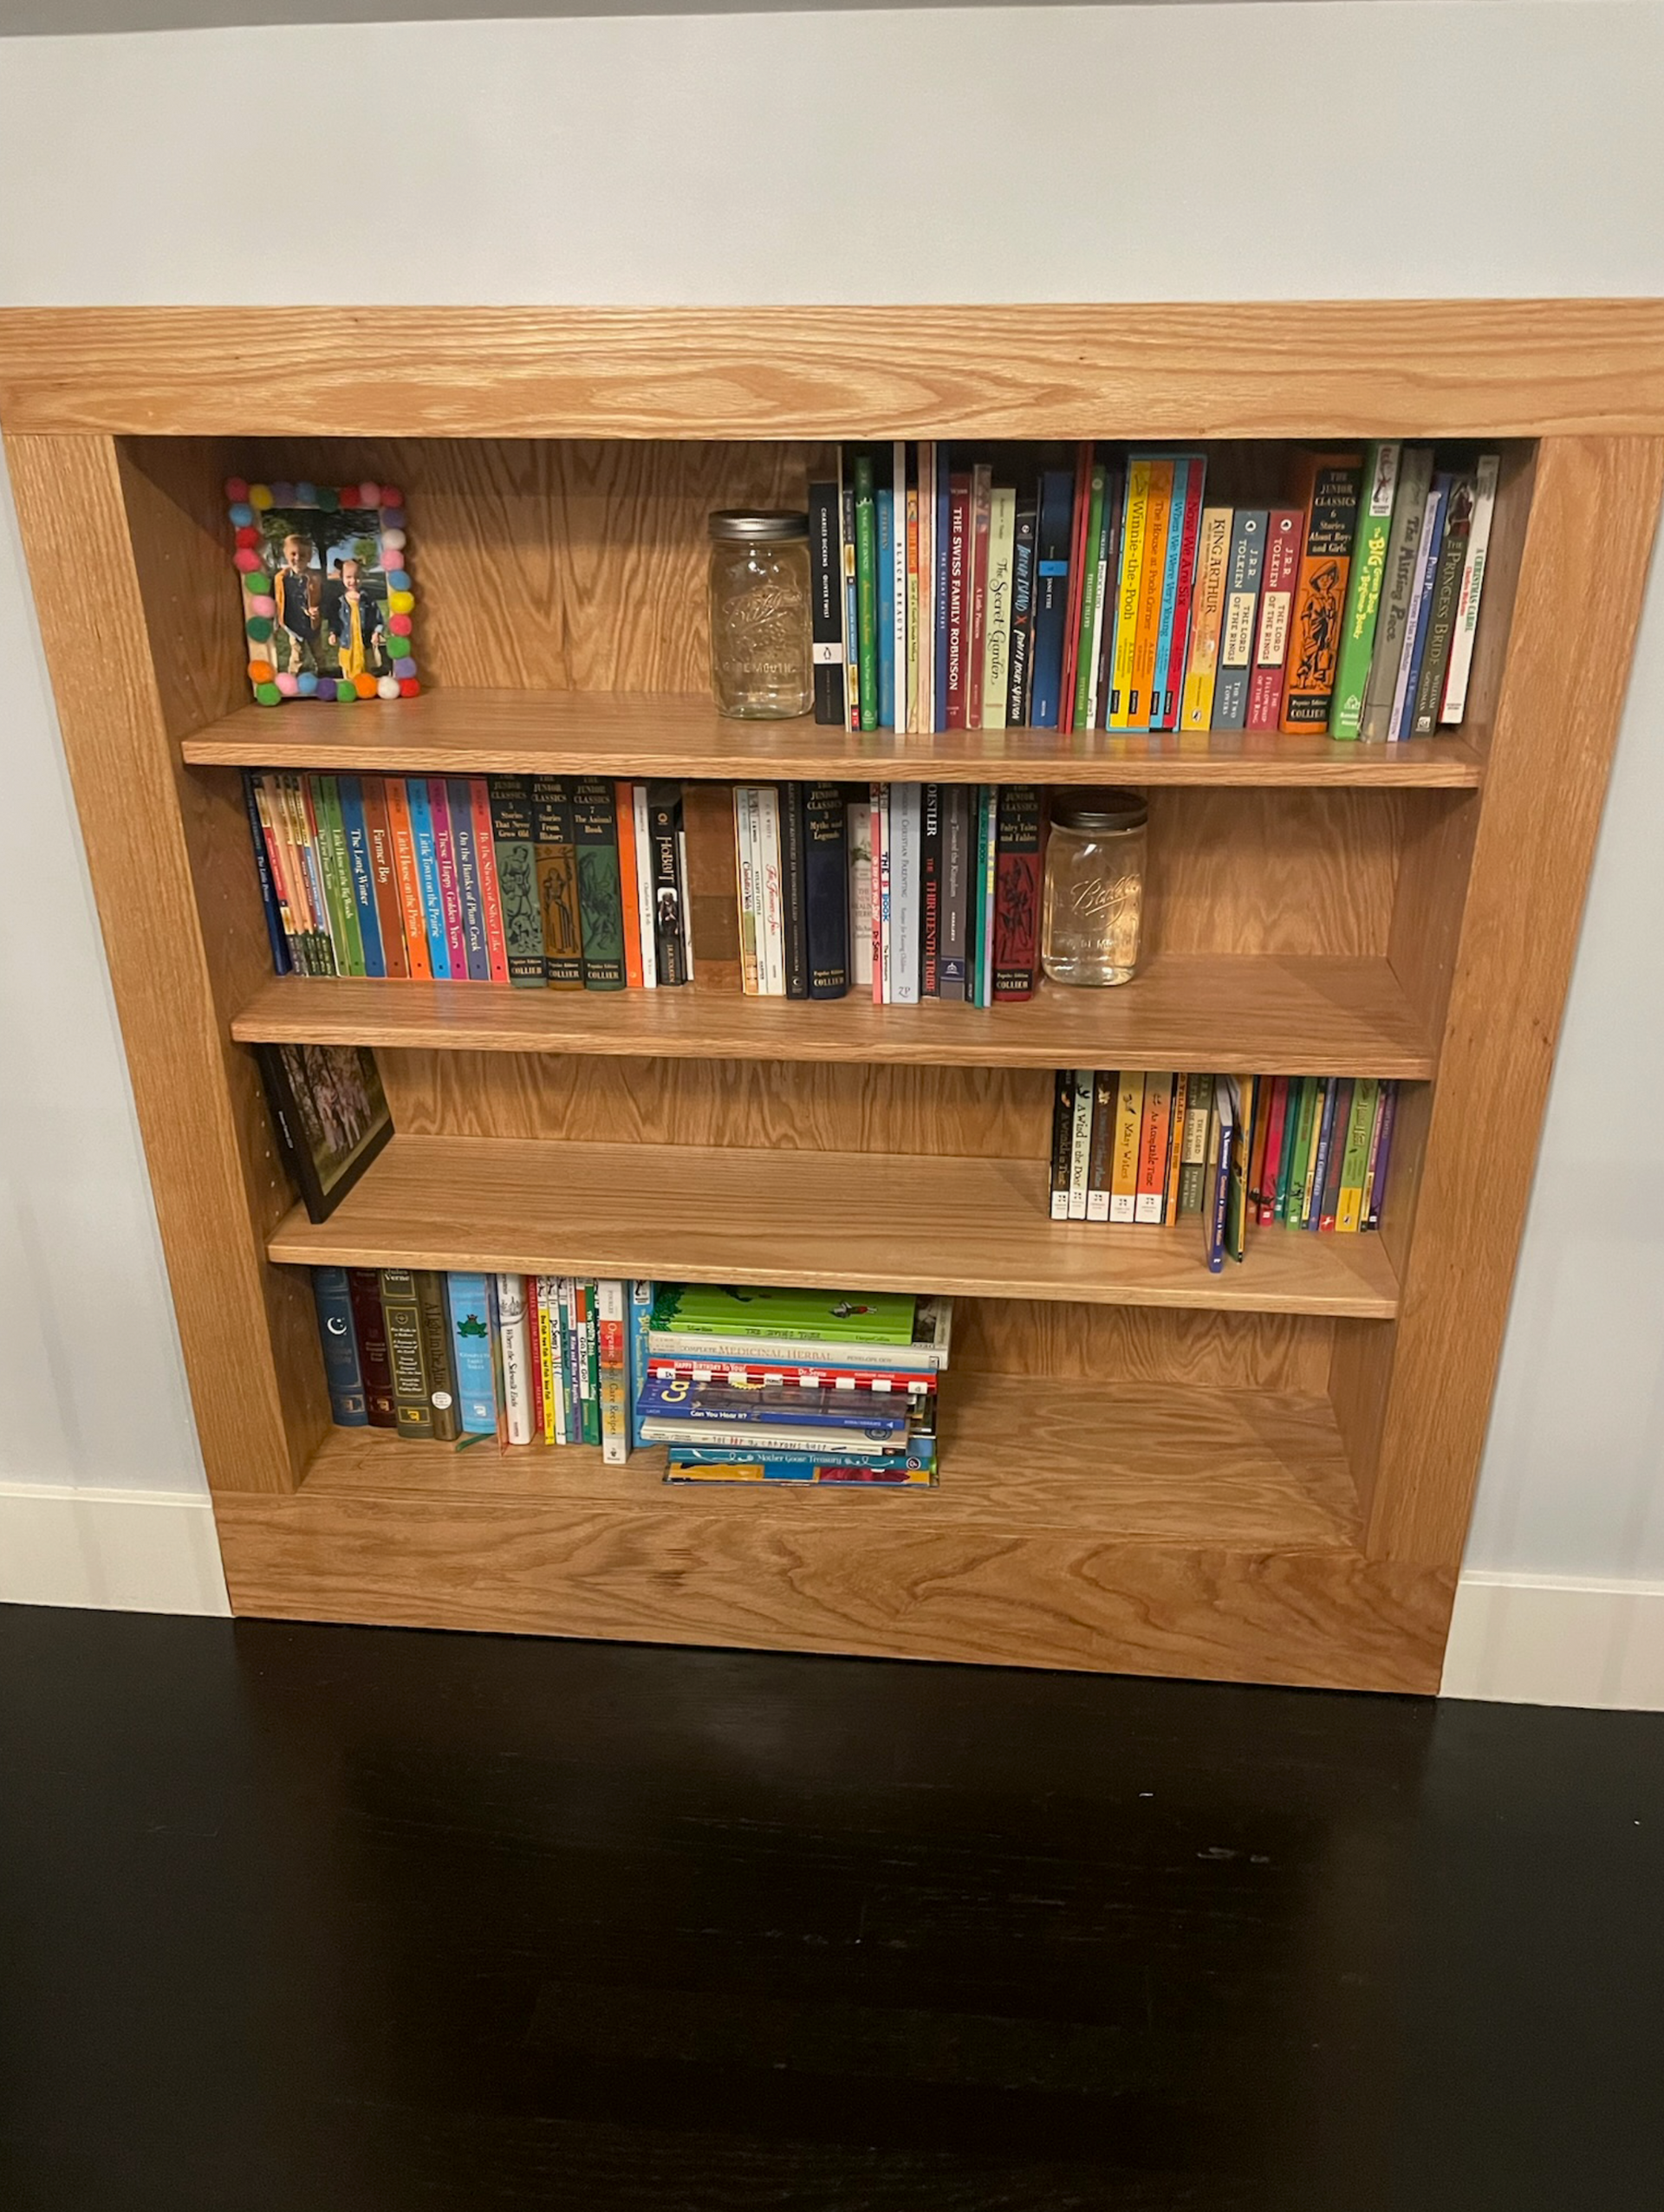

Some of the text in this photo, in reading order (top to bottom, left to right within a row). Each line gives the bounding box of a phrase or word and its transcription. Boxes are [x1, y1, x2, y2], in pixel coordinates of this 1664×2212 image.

[1320, 483, 1353, 495] JUNIOR
[1154, 501, 1164, 521] The
[1315, 497, 1355, 506] CLASSICS
[1172, 502, 1183, 532] When
[1151, 523, 1162, 555] House
[1170, 535, 1180, 550] We
[1212, 519, 1225, 555] KING
[1150, 557, 1158, 567] at
[1178, 502, 1197, 607] Now We Are Six
[1269, 537, 1283, 587] TOLKIEN
[1367, 536, 1385, 566] BIG
[996, 558, 1008, 579] The
[1167, 553, 1178, 580] Were
[1234, 539, 1246, 588] TOLKIEN
[1147, 570, 1157, 594] Pooh
[1205, 556, 1221, 617] ARTHUR
[1372, 568, 1382, 593] Green
[1386, 516, 1420, 643] The Missing Piece
[949, 507, 962, 691] THE SWISS FAMILY ROBINSON
[989, 578, 1009, 629] Secret
[1164, 581, 1175, 606] Very
[1268, 595, 1276, 609] OF
[1366, 593, 1378, 614] Book
[1144, 592, 1155, 631] Corner
[1160, 607, 1173, 637] Young
[1227, 596, 1241, 661] OF THE RINGS
[1238, 628, 1248, 653] LORD
[1273, 605, 1285, 652] THE LORD
[986, 630, 1006, 685] Garden
[1262, 632, 1272, 660] RINGS
[1290, 708, 1326, 719] COLLIER
[531, 794, 567, 803] CLASSICS
[573, 795, 610, 804] CLASSICS
[501, 811, 523, 821] Stories
[538, 814, 562, 823] Stories
[542, 822, 561, 832] From
[575, 814, 613, 824] The Animal
[317, 829, 327, 840] The
[498, 829, 530, 838] Grow Old
[539, 831, 563, 843] History
[584, 825, 603, 834] Book
[1000, 823, 1037, 834] Fairy Tales
[1000, 834, 1037, 842] and Fables
[319, 841, 328, 857] First
[373, 829, 390, 885] Farmer Boy
[901, 819, 910, 898] CHRISTIAN PARENTING
[258, 868, 267, 883] Little
[322, 857, 331, 872] Four
[350, 828, 370, 905] The Long Winter
[261, 884, 270, 902] Prince
[396, 831, 420, 938] Little House on the Prairie
[419, 833, 442, 938] Little Town on the Prairie
[438, 830, 460, 949] These Happy Golden Years
[458, 831, 481, 952] On the Banks of Plum Creek
[742, 861, 752, 910] Charlotte's Web
[881, 892, 890, 923] BOOK
[587, 970, 619, 979] COLLIER
[1076, 1113, 1088, 1138] Wind
[1077, 1140, 1085, 1149] in
[1121, 1123, 1134, 1179] Many Waters
[1146, 1111, 1162, 1187] An Acceptable Time
[1194, 1135, 1203, 1154] LORD
[1075, 1151, 1083, 1164] the
[1072, 1166, 1083, 1188] Door
[505, 1328, 515, 1349] Where
[679, 1346, 834, 1361] COMPLETE MEDICINAL HERBAL
[507, 1362, 518, 1390] Sidewalk
[607, 1322, 619, 1436] Organic Body Care Recipes
[510, 1391, 518, 1408] Ends
[757, 1453, 842, 1465] Mother Goose Treasury
